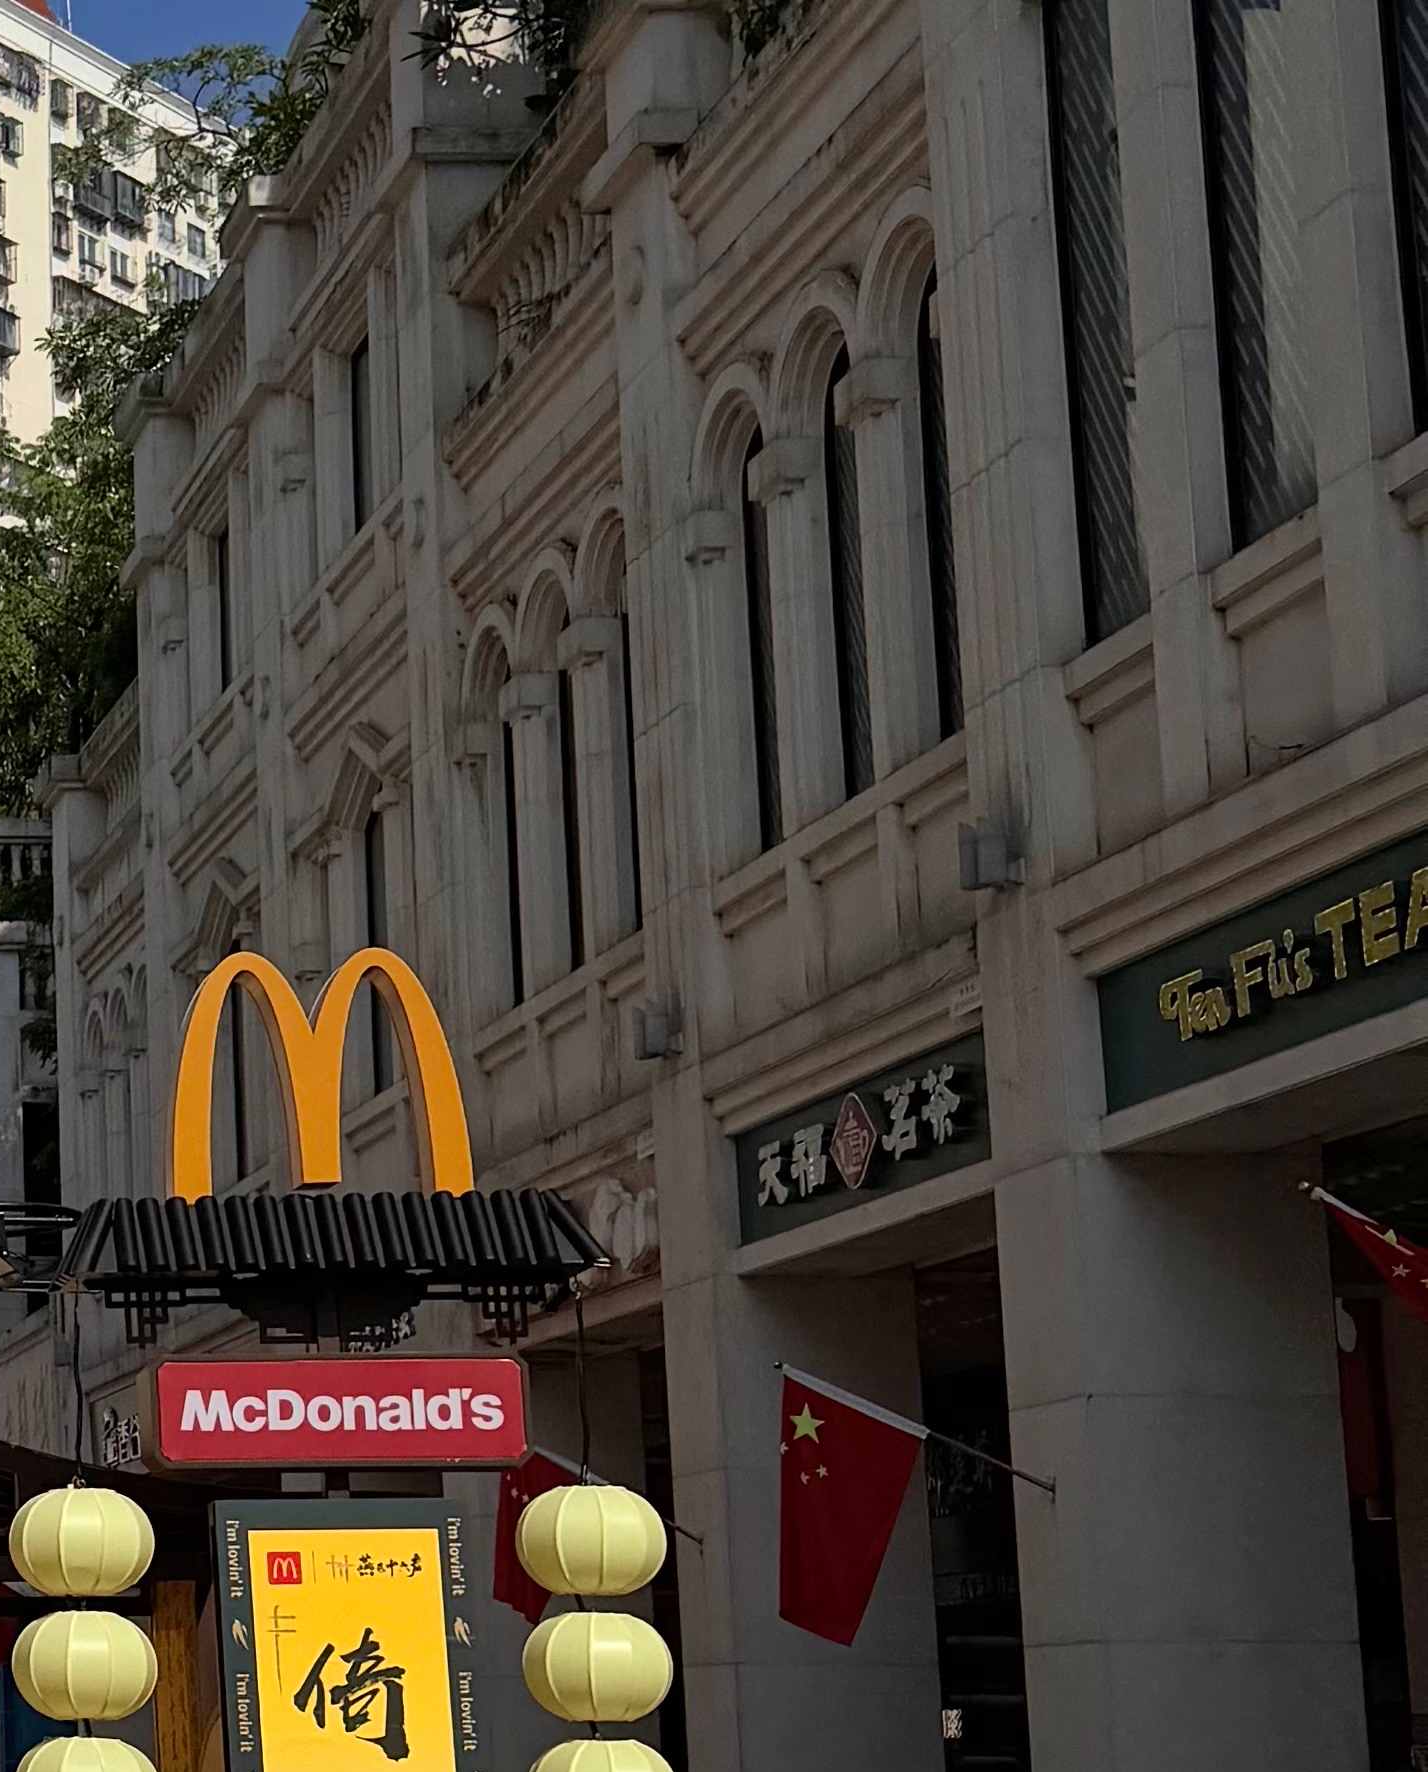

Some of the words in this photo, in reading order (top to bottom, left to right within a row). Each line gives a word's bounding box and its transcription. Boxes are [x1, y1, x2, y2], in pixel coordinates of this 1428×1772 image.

[1160, 969, 1231, 1041] Ten
[1229, 929, 1314, 1018] Fu's
[181, 1386, 505, 1433] McDonald's
